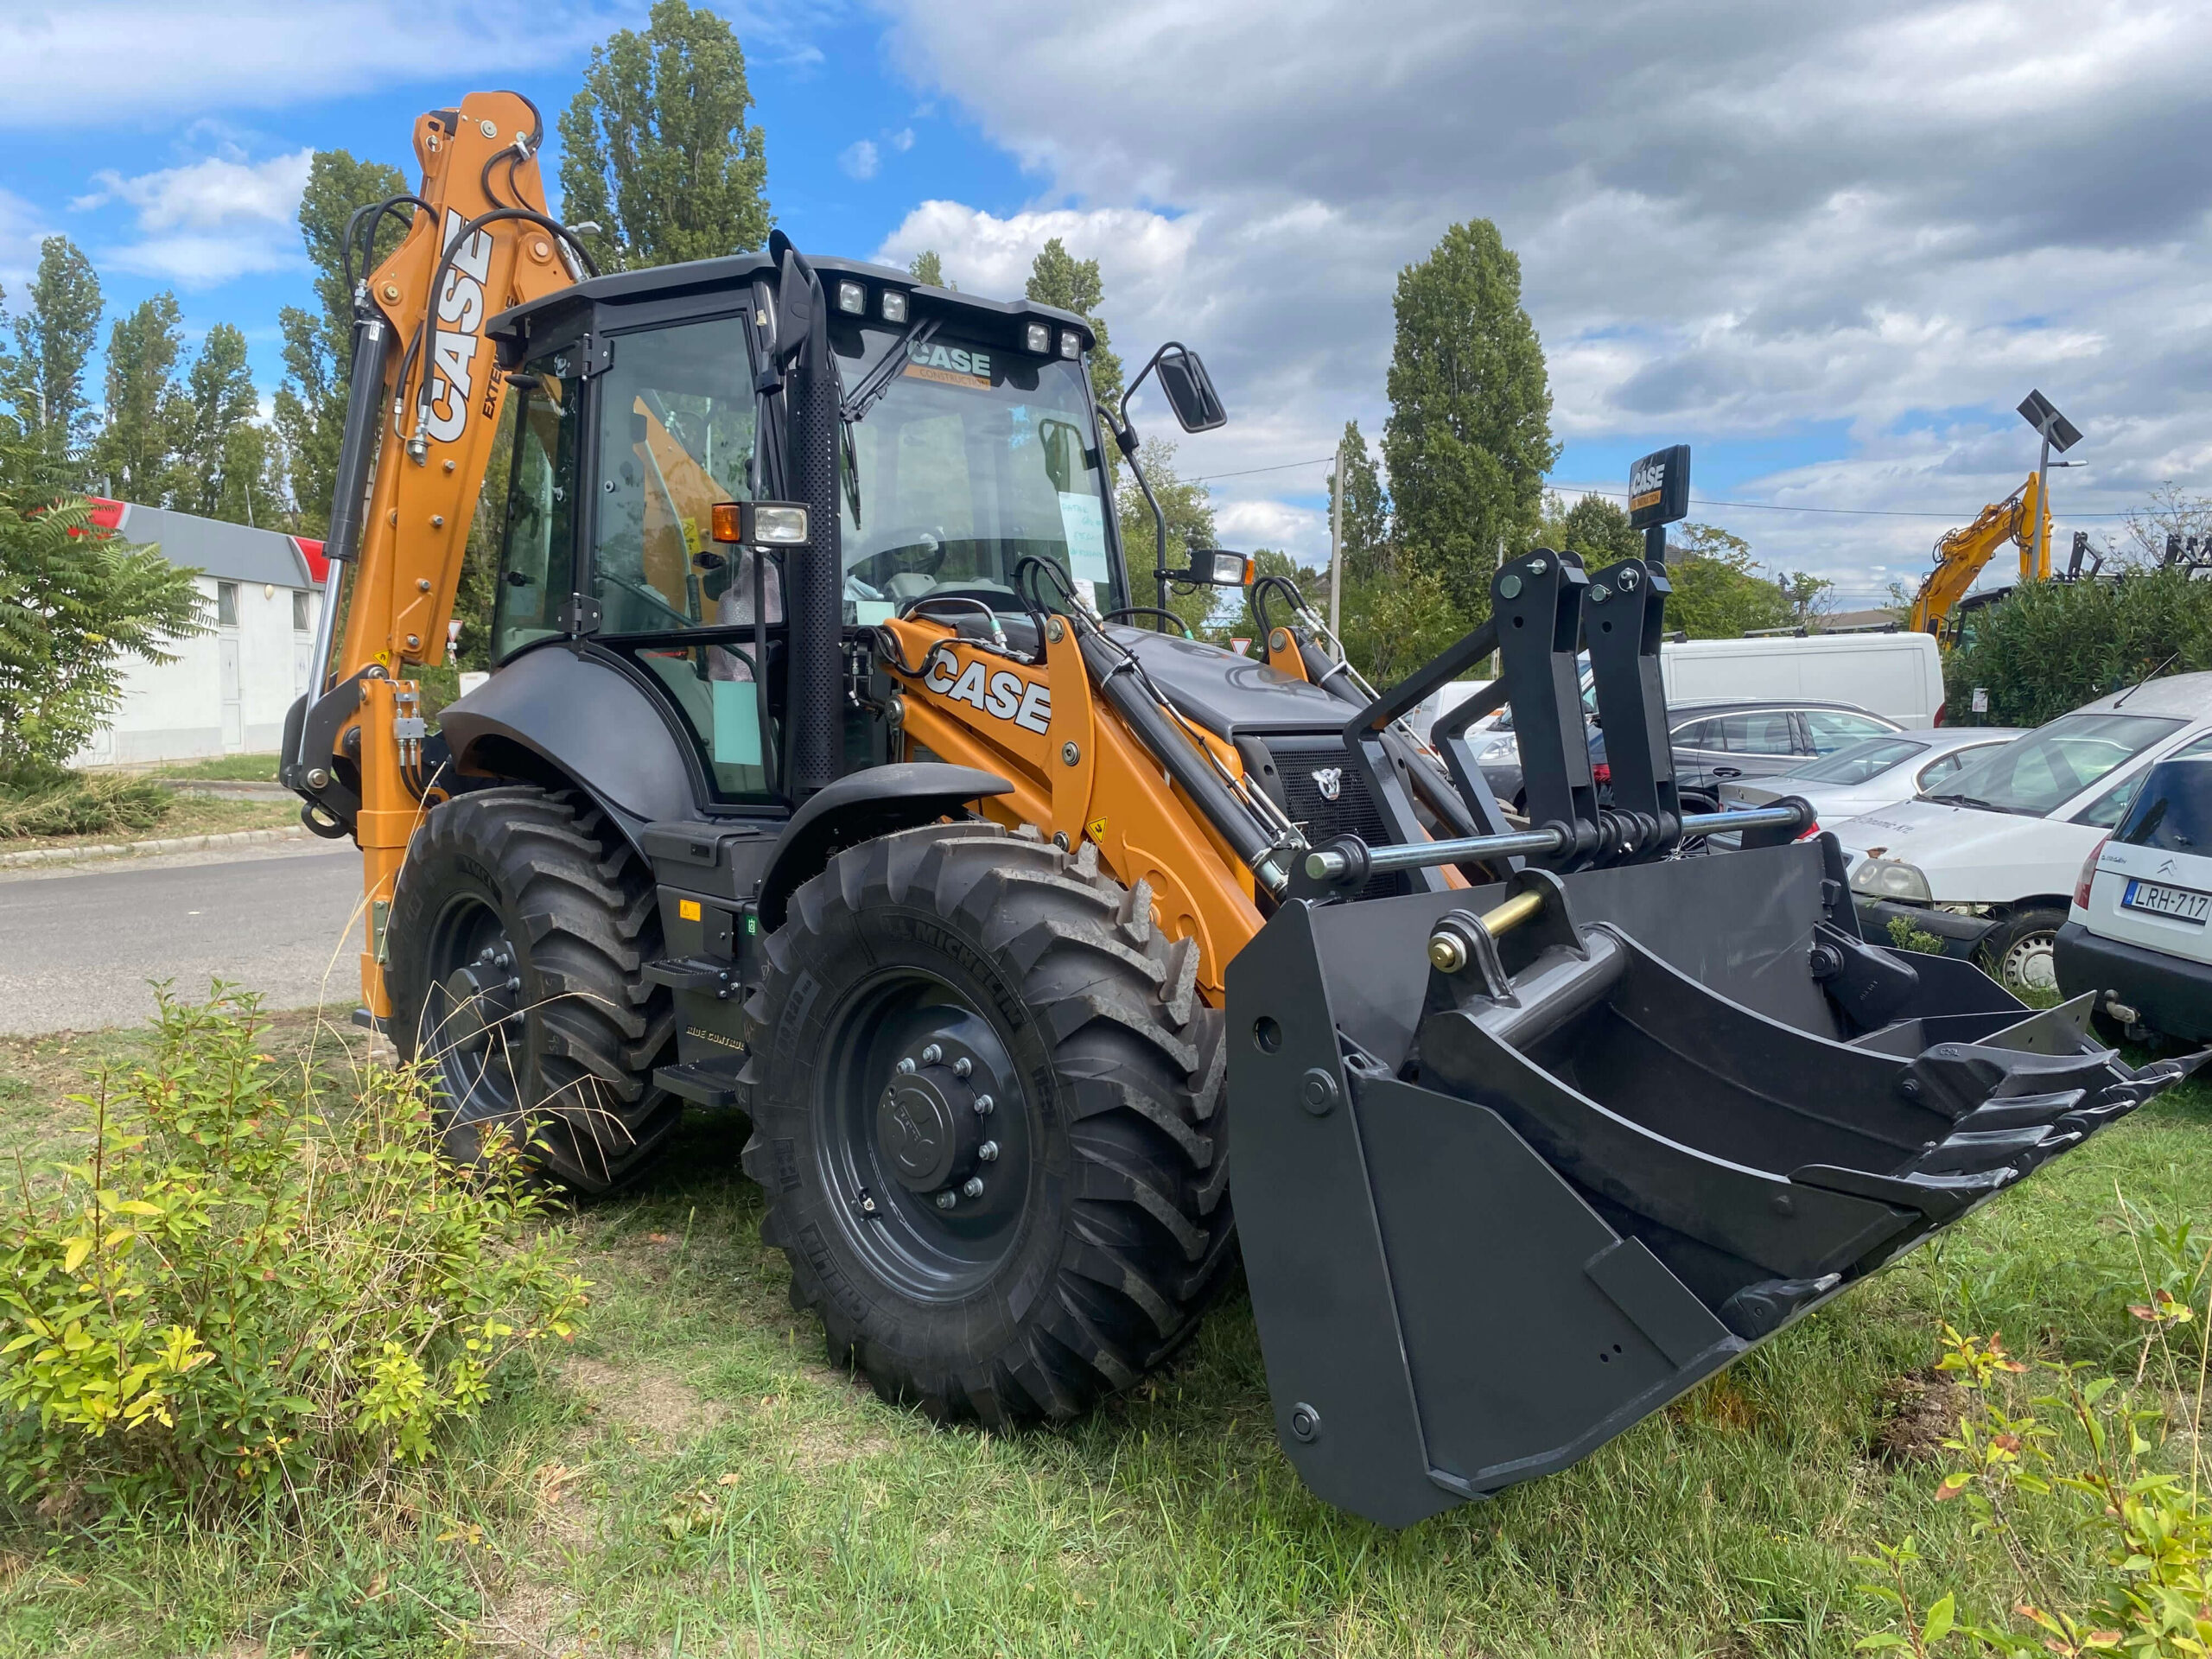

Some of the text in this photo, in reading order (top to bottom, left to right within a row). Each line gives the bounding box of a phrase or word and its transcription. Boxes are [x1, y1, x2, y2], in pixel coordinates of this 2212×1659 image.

[416, 207, 494, 443] CASE
[907, 340, 991, 377] CASE
[1630, 463, 1666, 496] CASE
[924, 647, 1052, 736] CASE
[2135, 885, 2209, 917] LRH-717
[915, 919, 1025, 1029] MICHELIN
